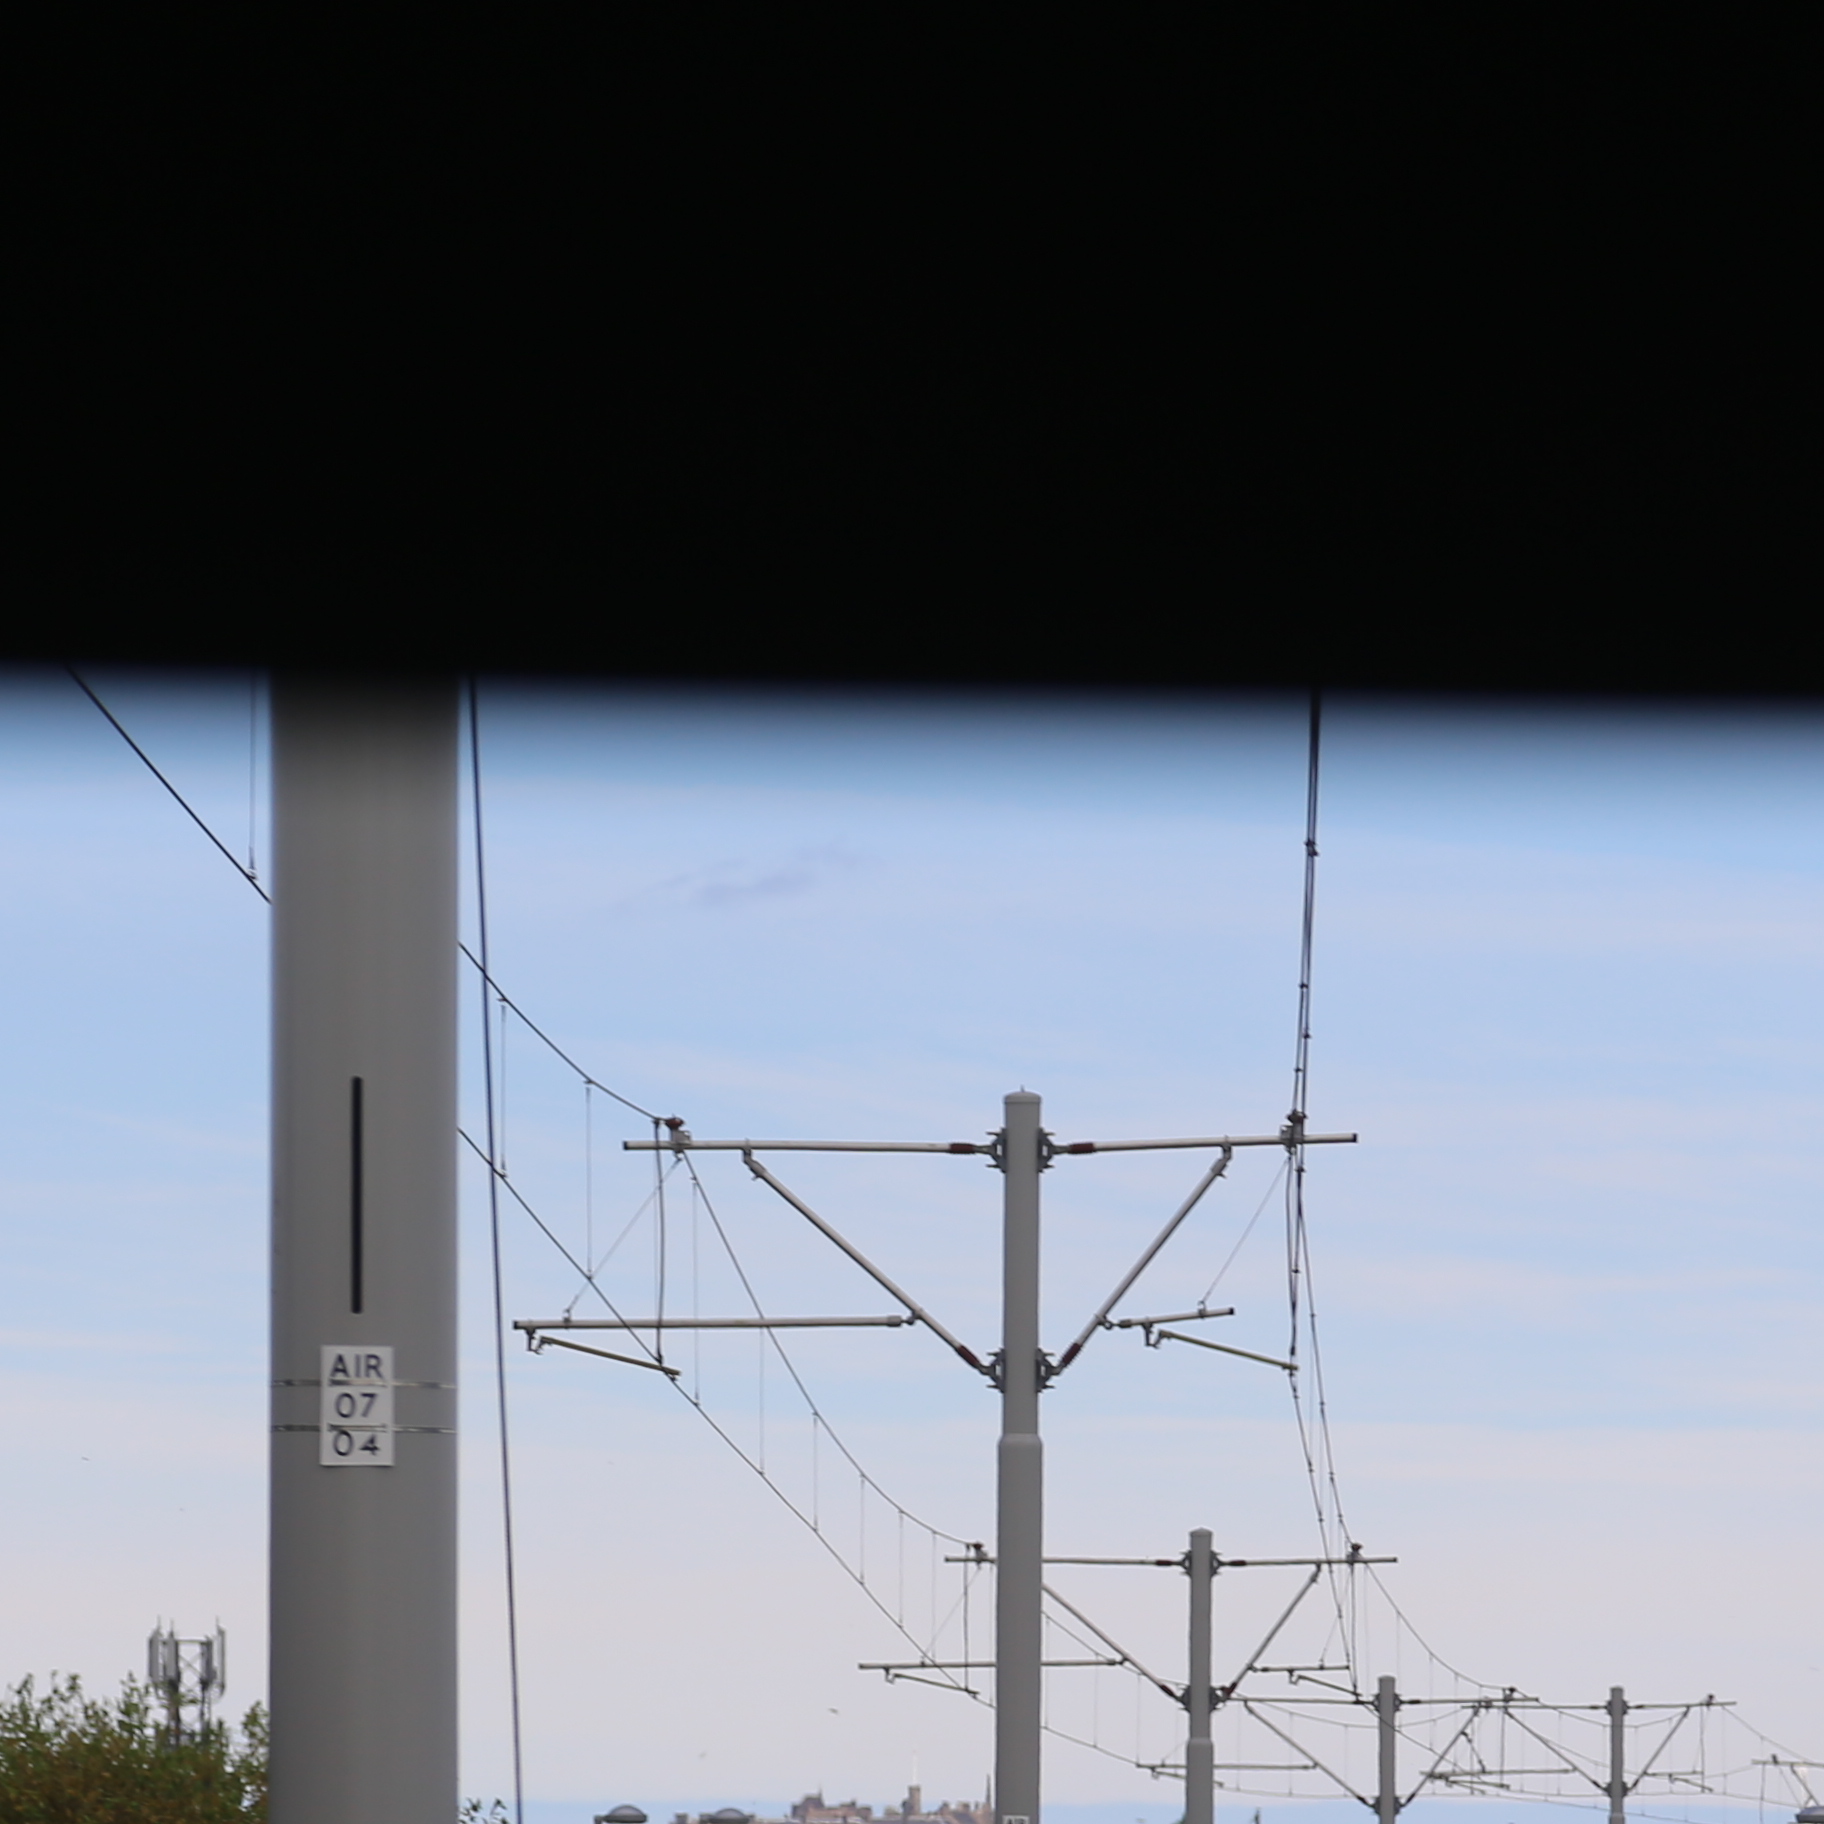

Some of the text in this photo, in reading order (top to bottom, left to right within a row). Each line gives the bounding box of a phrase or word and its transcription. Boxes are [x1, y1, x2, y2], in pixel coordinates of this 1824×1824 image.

[331, 1354, 384, 1378] AIR
[335, 1393, 378, 1418] 07
[333, 1430, 380, 1456] 04
